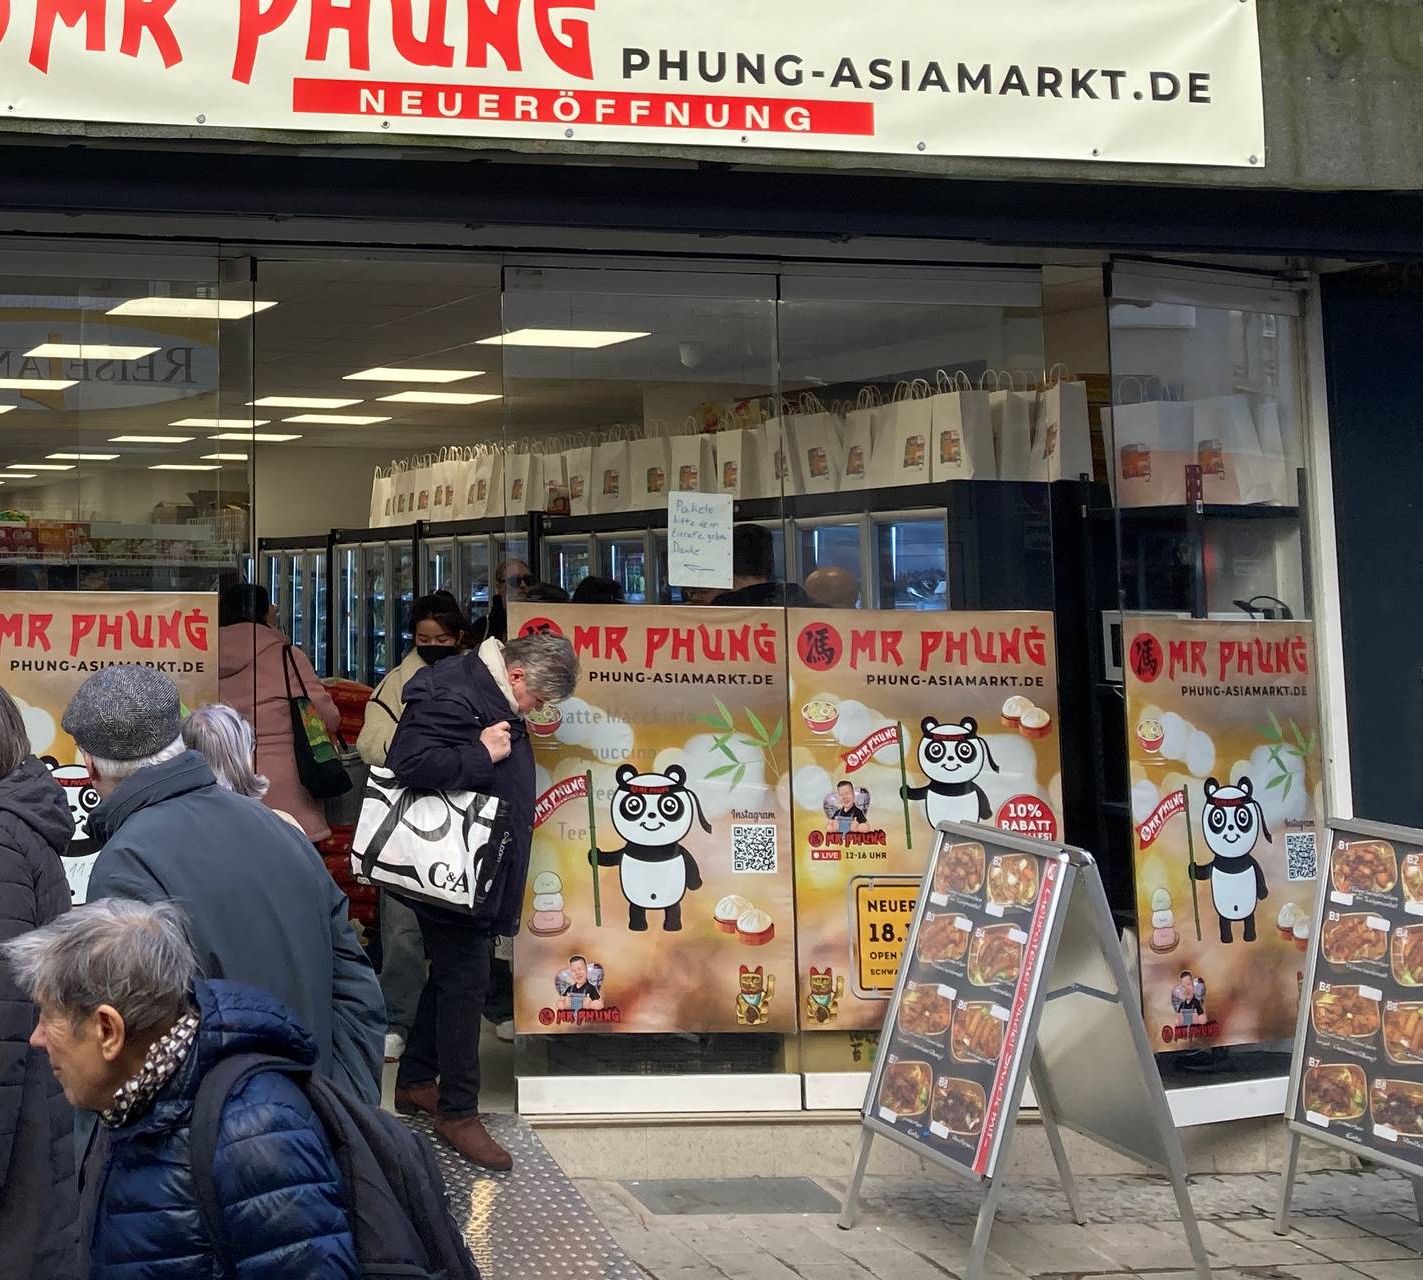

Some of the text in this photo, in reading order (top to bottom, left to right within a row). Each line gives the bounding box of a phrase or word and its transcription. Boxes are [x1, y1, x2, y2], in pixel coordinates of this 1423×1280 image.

[28, 0, 594, 85] MR PHUNG
[622, 48, 1211, 103] PHUNG-ASIAMARKT.DE
[359, 88, 812, 131] NEUERÖFFNUNG
[69, 608, 209, 657] PHUNG
[574, 623, 776, 669] MR PHUNG
[849, 625, 1046, 672] MR PHUNG
[1168, 636, 1308, 682] MR PHUNG
[589, 672, 774, 685] PHUNG-ASIAMARKT.DE
[867, 674, 1043, 687] PHUNG-ASIAMARKT.DE
[1181, 686, 1307, 697] PHUNG-ASIAMARKT.DE
[563, 709, 602, 724] atte
[549, 777, 585, 808] PHUNG
[730, 809, 776, 823] Instagram
[1009, 804, 1042, 817] 10%
[557, 821, 587, 840] Tee
[1001, 820, 1051, 831] RABATT
[1338, 840, 1349, 850] B1
[993, 856, 1003, 867] B2
[1407, 854, 1419, 865] B2
[428, 862, 469, 894] C&A
[867, 900, 917, 912] NEUER
[1329, 911, 1340, 921] B3
[870, 952, 897, 960] OPEN
[1319, 982, 1330, 992] B5
[1308, 1057, 1320, 1067] B7
